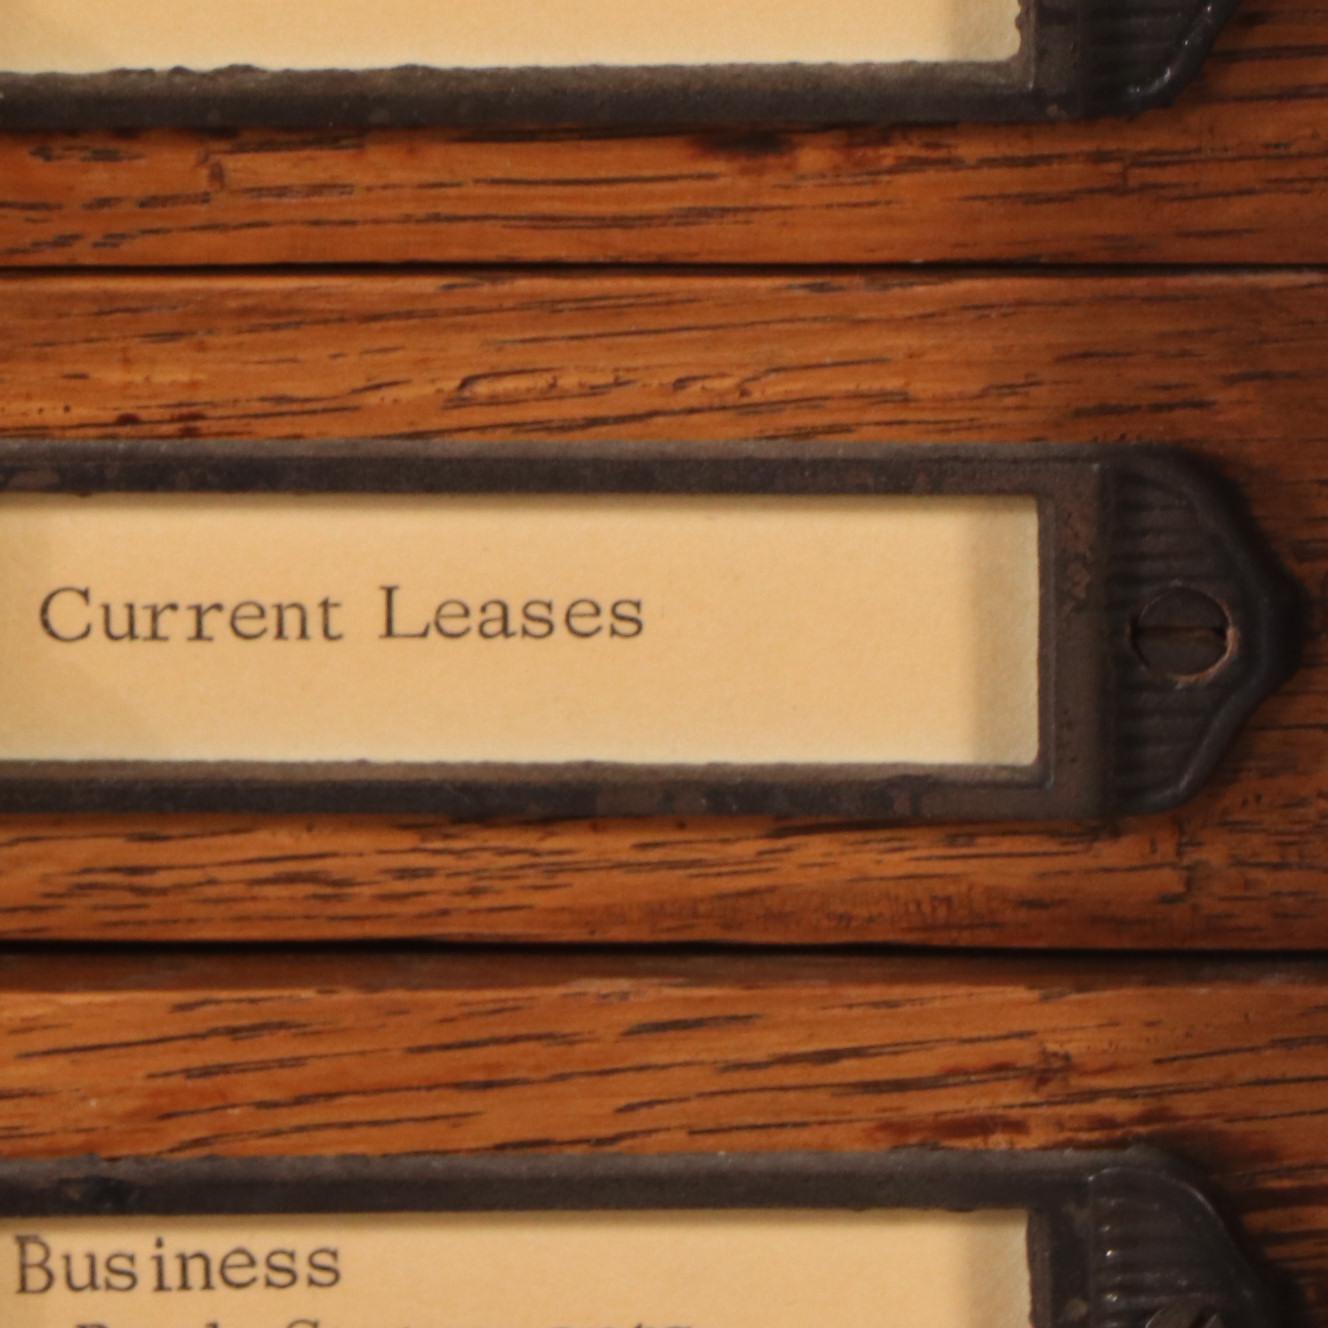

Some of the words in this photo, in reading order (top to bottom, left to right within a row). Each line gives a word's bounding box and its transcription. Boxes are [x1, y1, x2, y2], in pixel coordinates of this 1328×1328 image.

[39, 586, 343, 643] Current
[379, 584, 646, 641] Leases
[13, 1234, 343, 1296] Business
